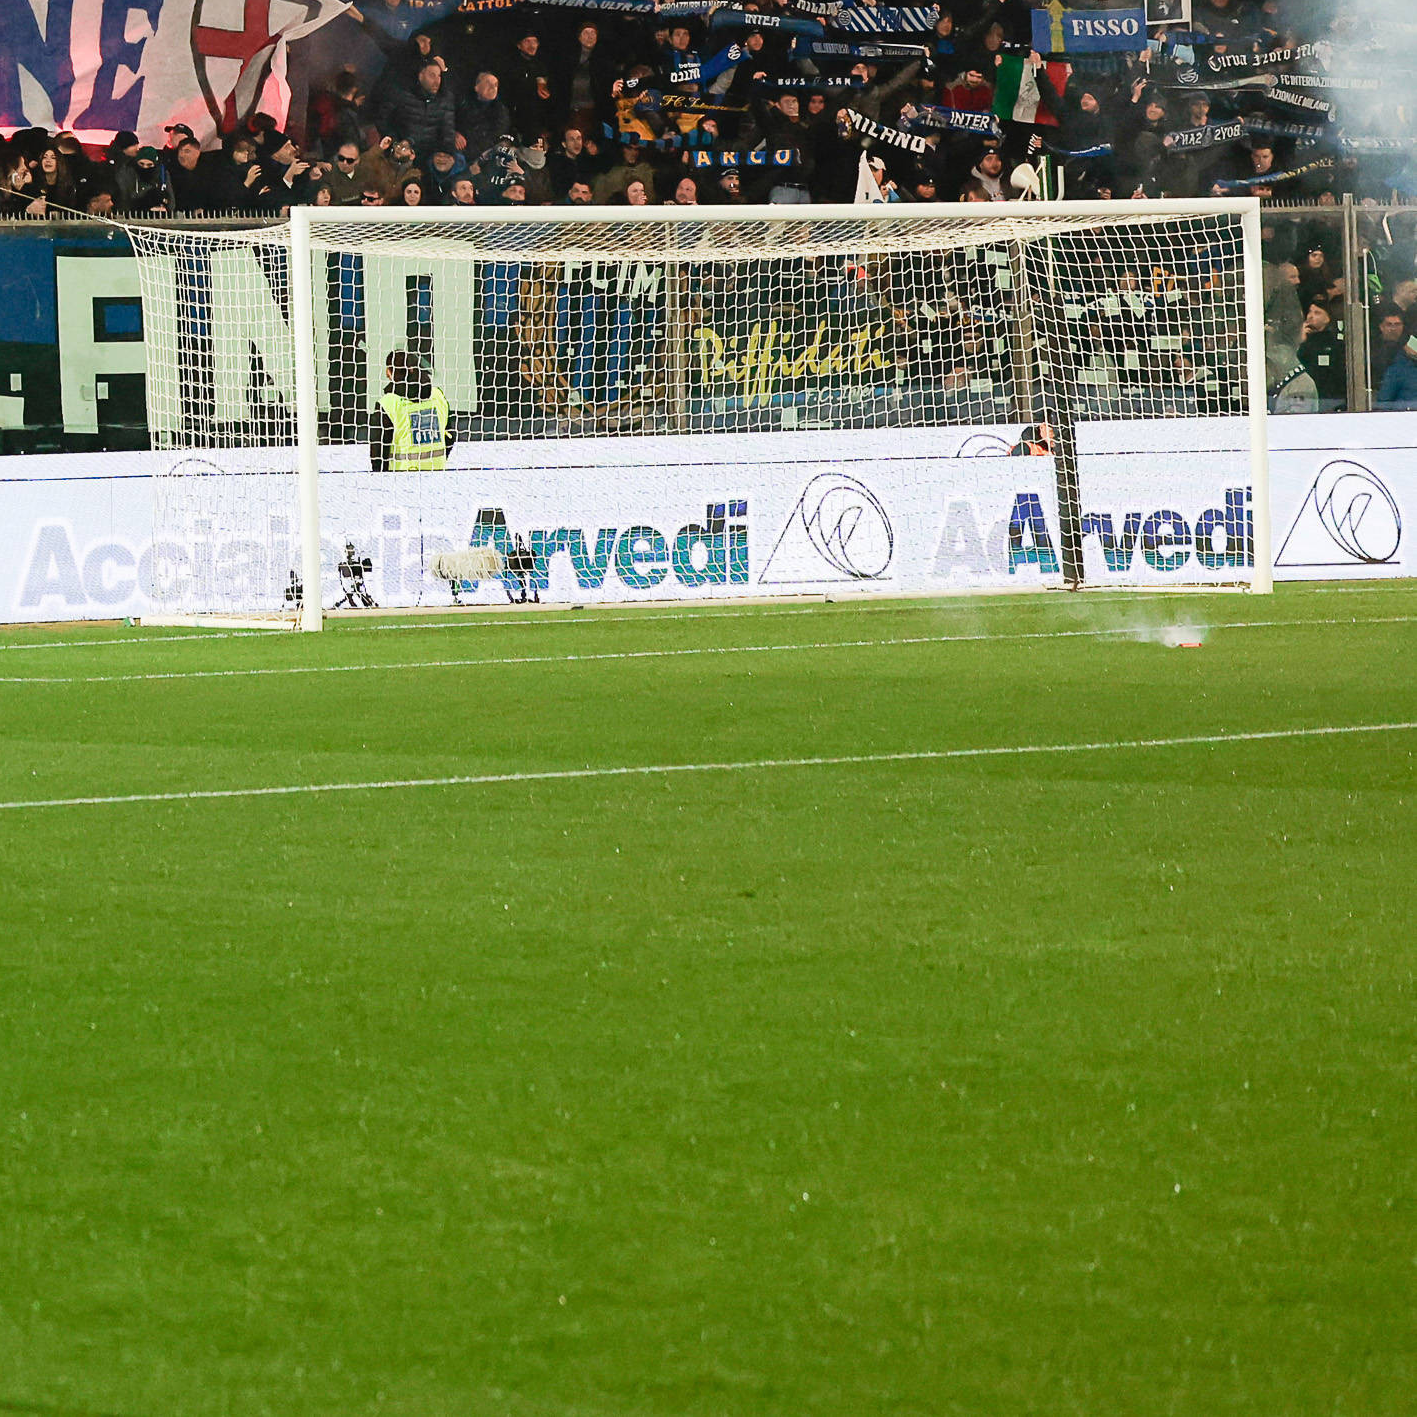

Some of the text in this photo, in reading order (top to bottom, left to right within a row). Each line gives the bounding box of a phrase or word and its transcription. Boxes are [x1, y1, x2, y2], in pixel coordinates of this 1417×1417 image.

[744, 13, 781, 27] INTER
[1072, 16, 1140, 39] FISSO
[847, 108, 926, 154] MILANO
[950, 110, 991, 129] INTER
[1008, 485, 1255, 575] Arvedi
[21, 498, 750, 608] Acciaieria Arvedi
